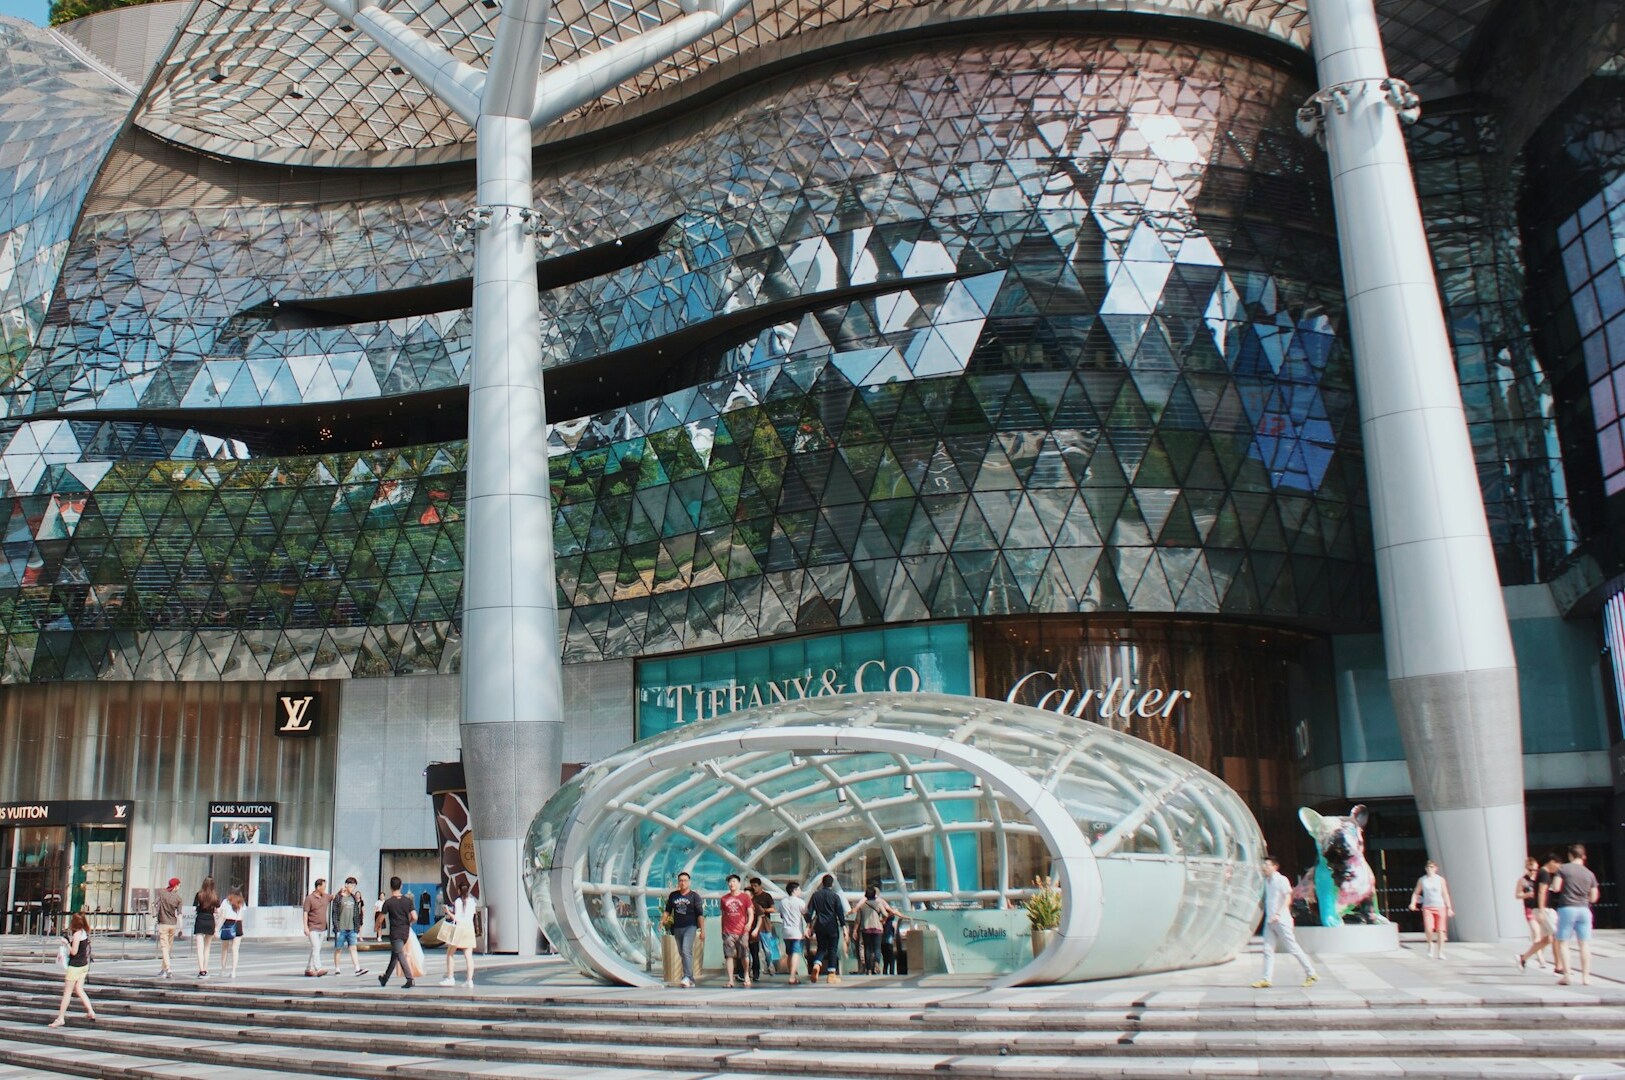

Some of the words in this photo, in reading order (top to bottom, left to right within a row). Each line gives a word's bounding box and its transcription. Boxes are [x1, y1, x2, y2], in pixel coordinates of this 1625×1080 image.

[666, 675, 813, 723] TIFFANY
[817, 668, 847, 697] &
[1007, 671, 1191, 718] Cartier
[7, 806, 49, 819] VUITTON
[211, 805, 235, 814] LOUIS
[237, 805, 272, 814] VUITTON
